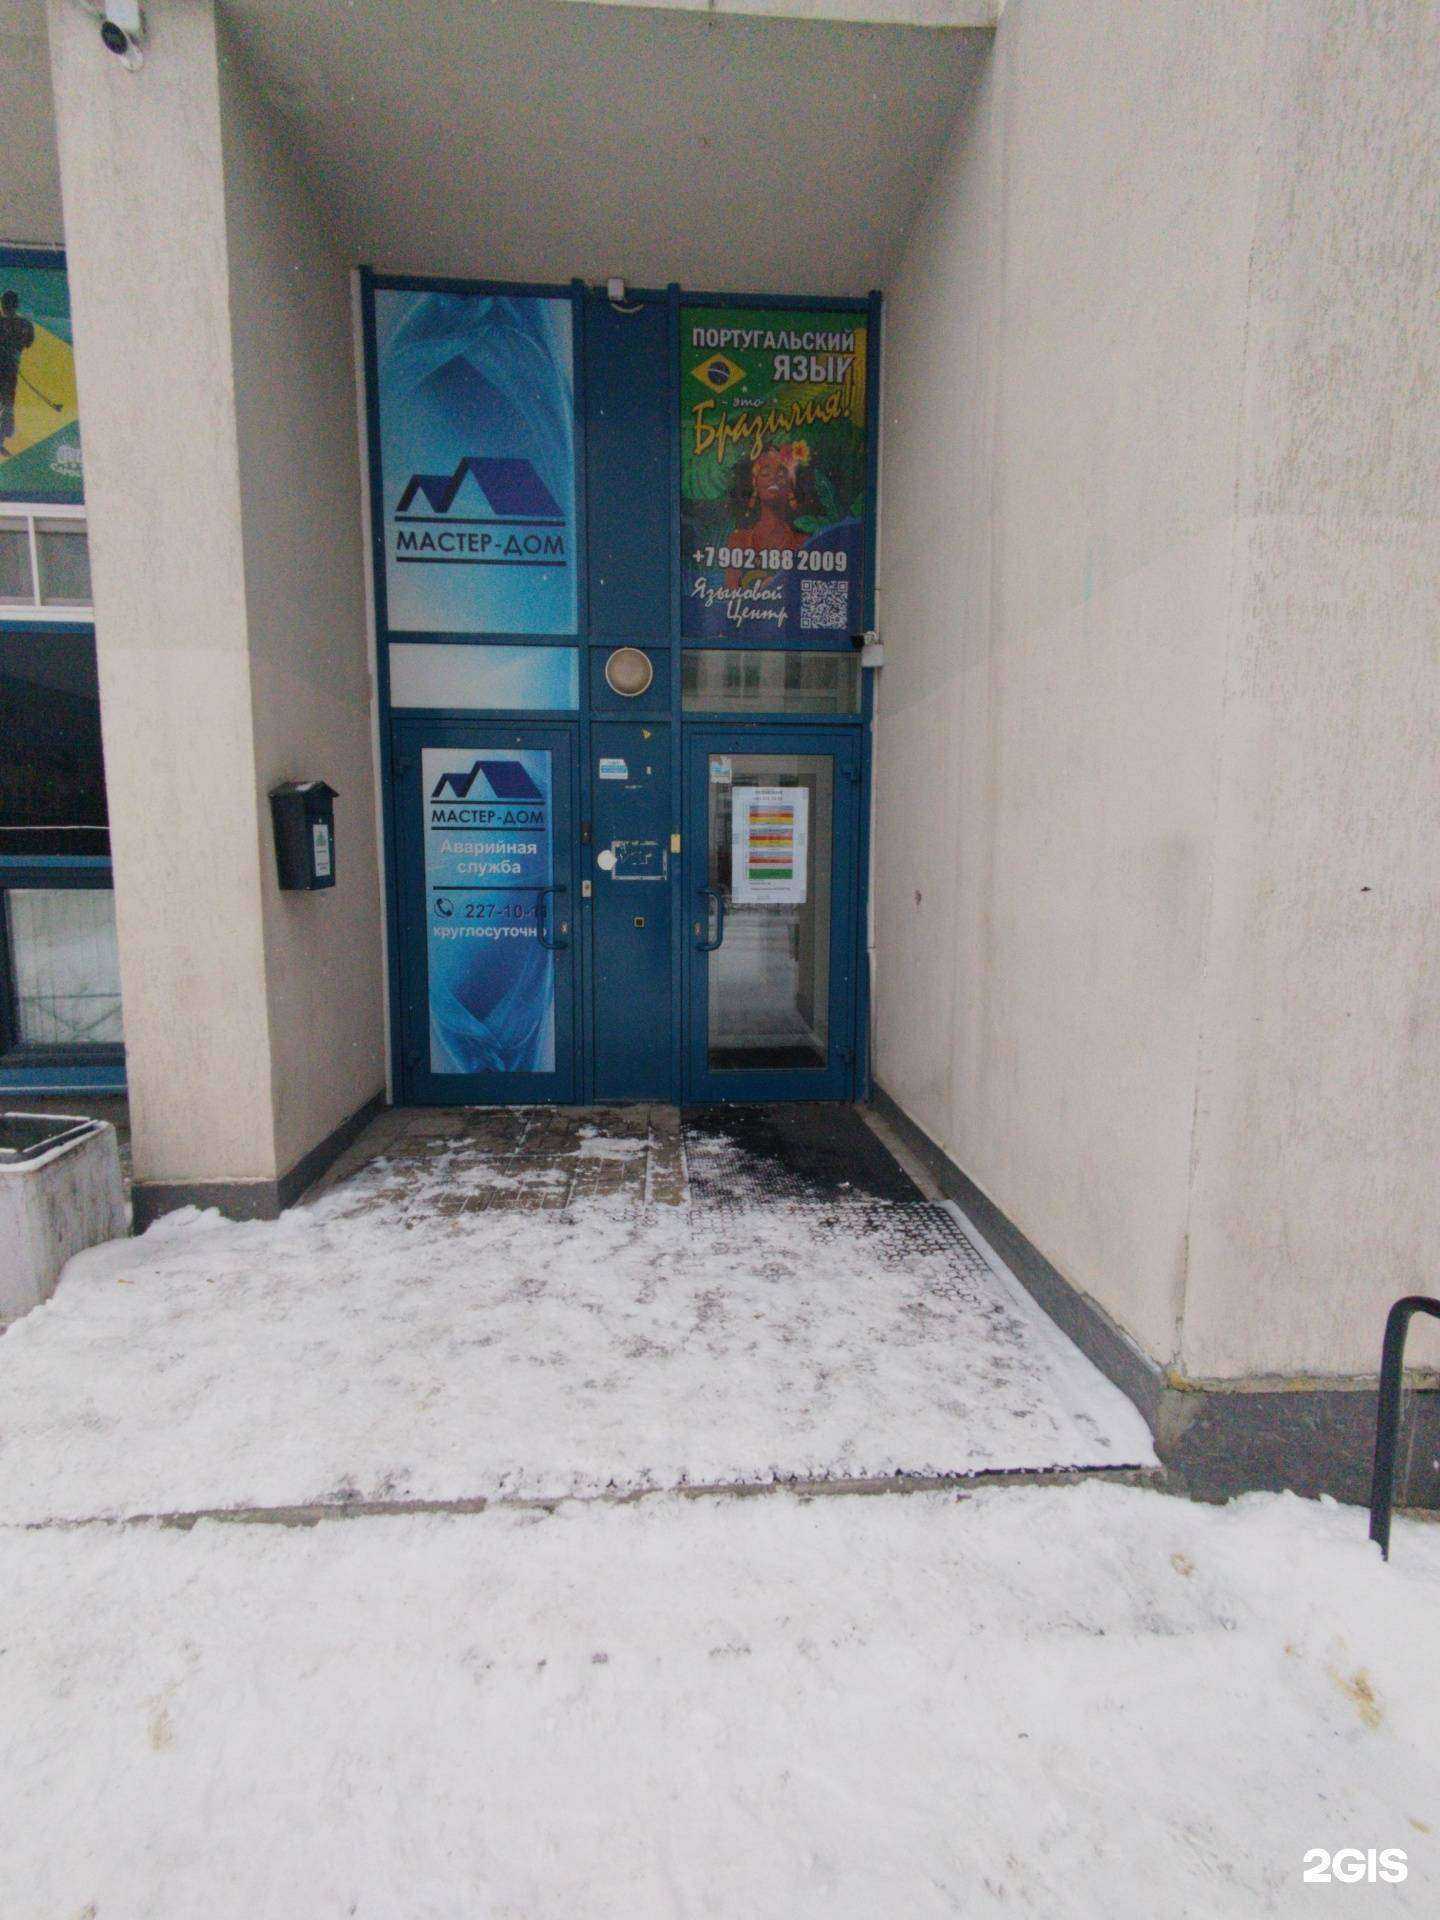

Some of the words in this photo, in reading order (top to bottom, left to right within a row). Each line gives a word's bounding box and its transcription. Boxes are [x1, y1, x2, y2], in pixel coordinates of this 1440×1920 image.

[692, 327, 855, 352] ПОРТУГАЛЬСКИЙ
[773, 353, 855, 383] ЯЗЫК
[396, 530, 565, 556] МАСТЕР-ДОМ
[692, 546, 715, 567] +7
[718, 547, 756, 569] 902
[759, 549, 794, 571] 188
[797, 550, 848, 573] 2009
[691, 576, 784, 608] Языковой
[726, 599, 789, 629] Центр
[431, 809, 545, 826] МАСТЕР-ДОМ
[440, 838, 538, 857] Аварийная
[457, 859, 522, 877] служба
